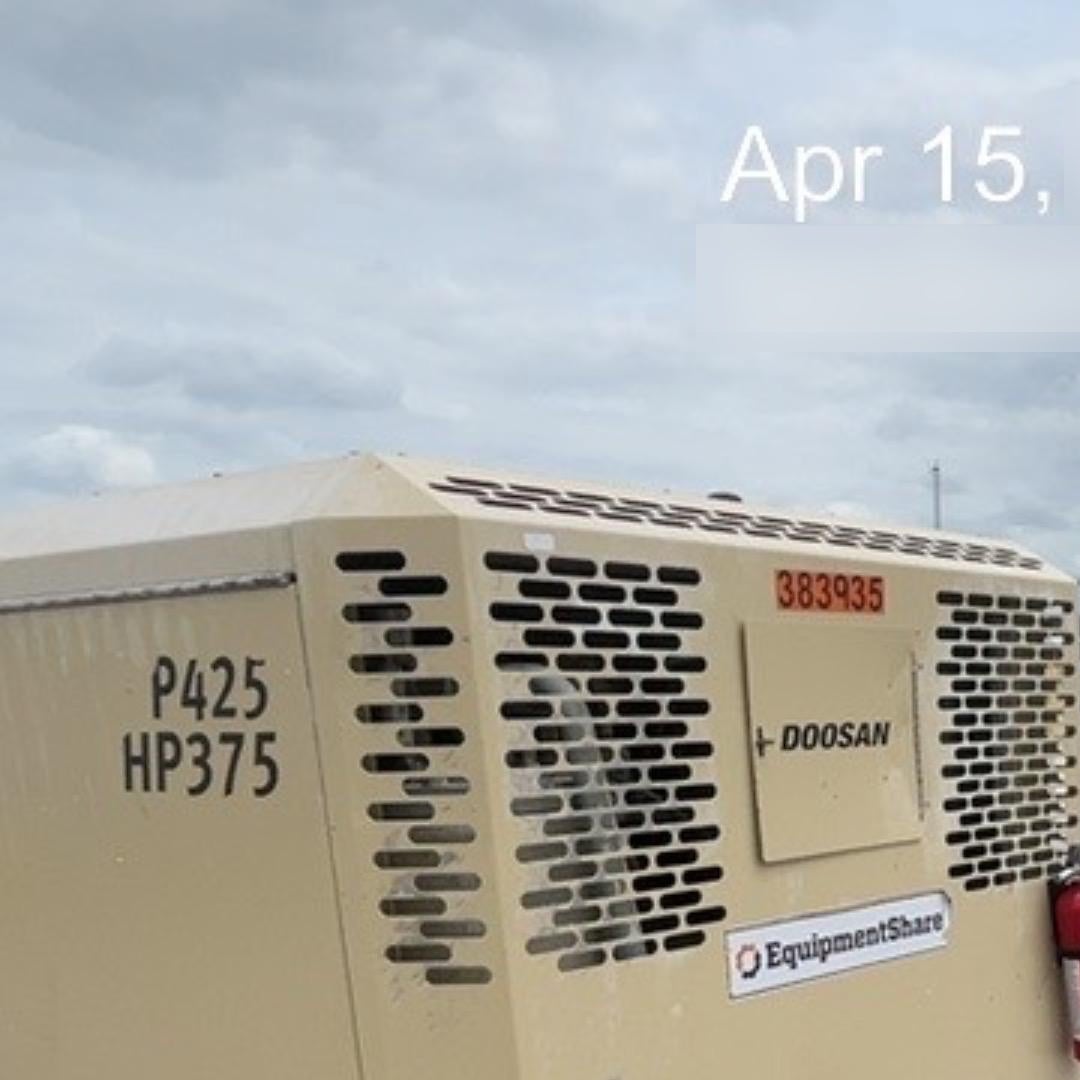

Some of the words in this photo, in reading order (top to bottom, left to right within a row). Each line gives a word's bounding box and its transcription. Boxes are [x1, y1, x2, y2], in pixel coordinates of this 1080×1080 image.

[777, 570, 884, 612] 383935
[151, 656, 268, 721] P425
[122, 731, 280, 798] HP375
[780, 720, 891, 753] DOOSAN
[765, 906, 944, 970] EquipmentShare
